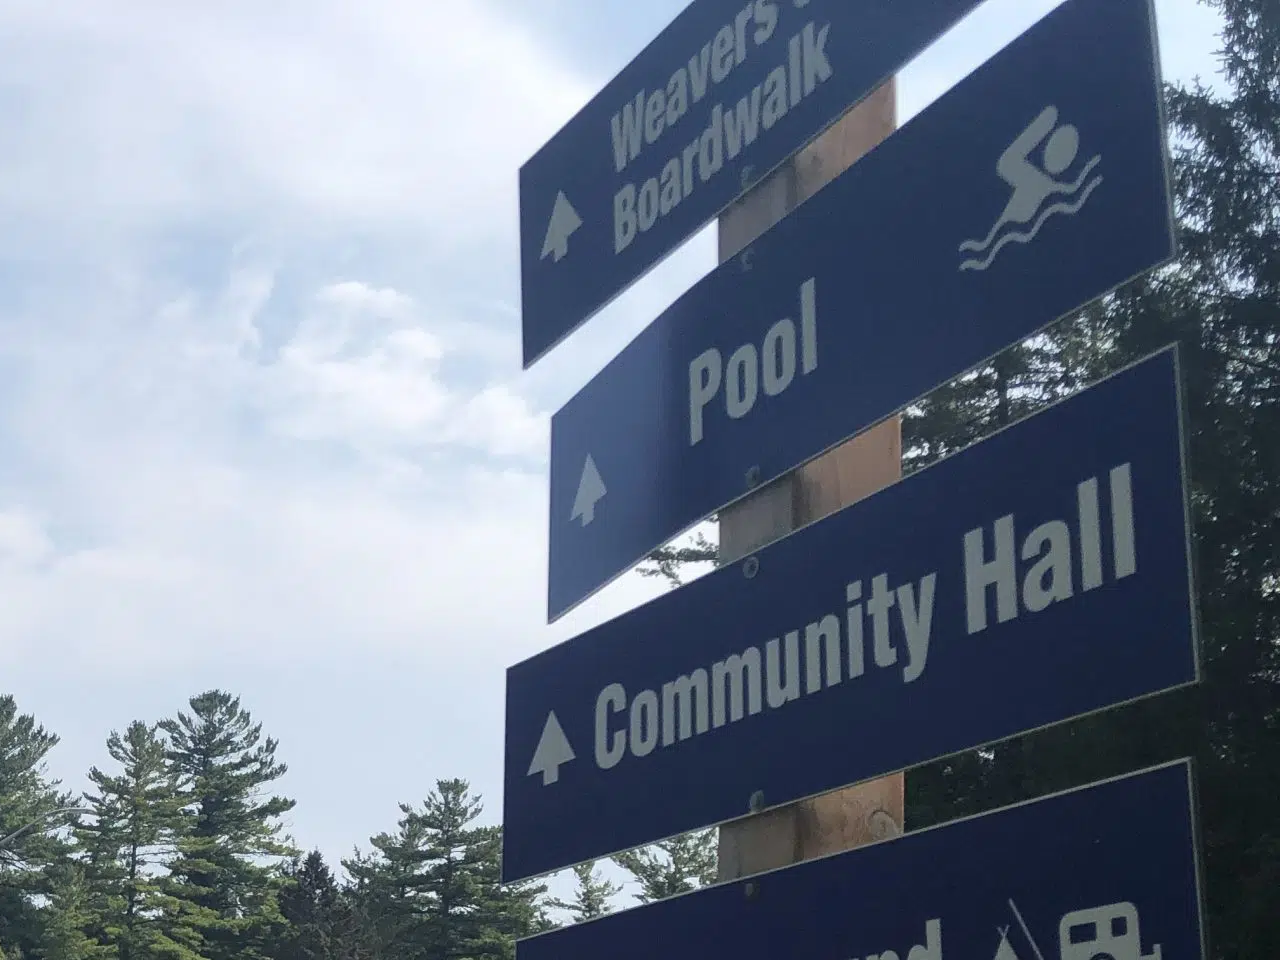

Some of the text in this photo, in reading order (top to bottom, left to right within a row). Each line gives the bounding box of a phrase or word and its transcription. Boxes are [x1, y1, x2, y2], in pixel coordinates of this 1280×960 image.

[611, 0, 778, 171] Weavers
[614, 22, 833, 254] Boardwalk
[689, 277, 818, 446] Pool
[594, 463, 1137, 769] Community Hall
